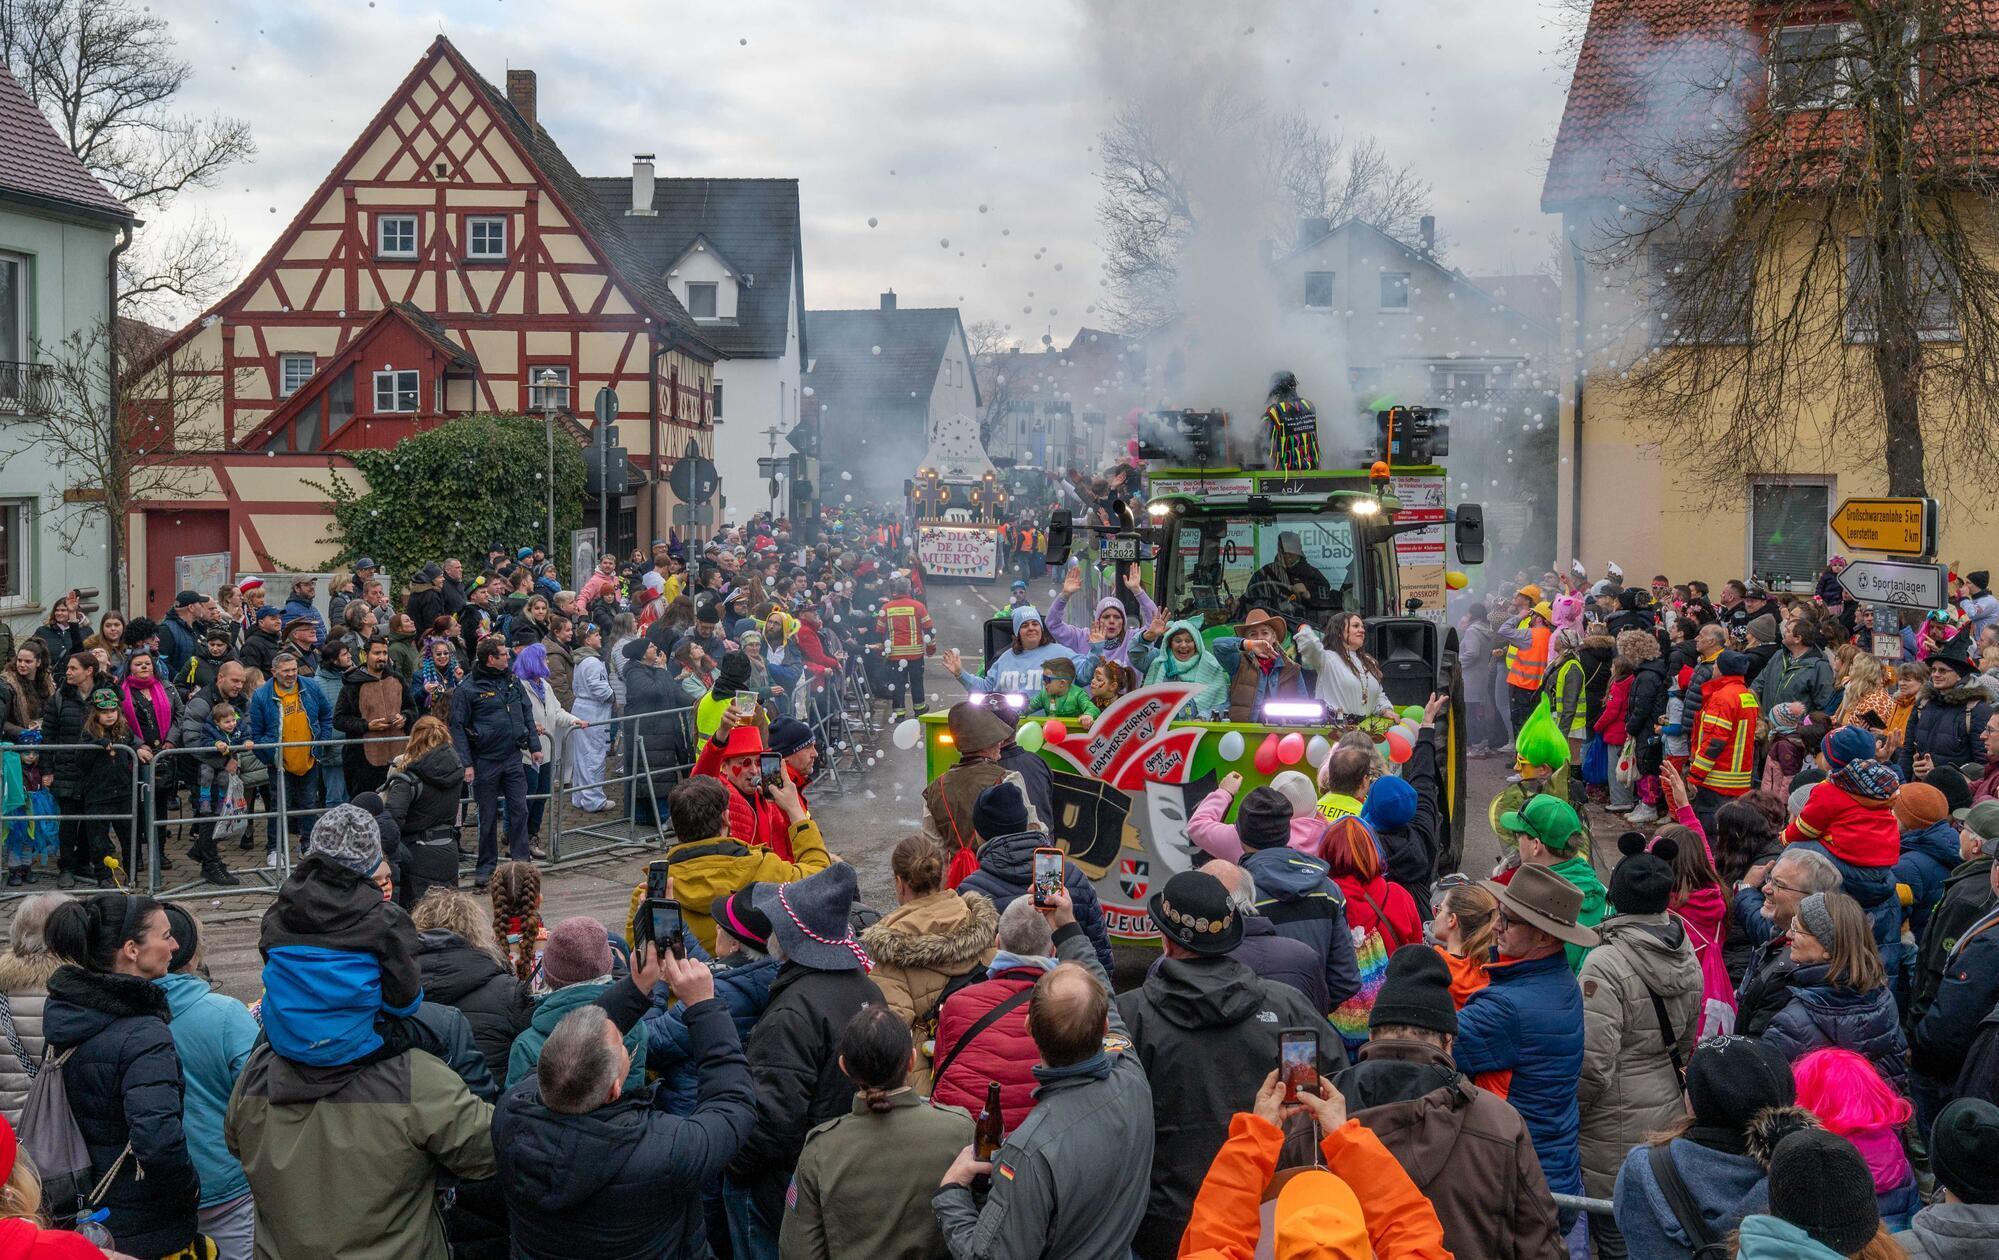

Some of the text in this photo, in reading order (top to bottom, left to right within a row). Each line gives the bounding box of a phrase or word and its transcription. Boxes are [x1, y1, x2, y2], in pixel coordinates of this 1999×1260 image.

[1846, 508, 1920, 523] Großschwarzenlohe 5 km
[947, 531, 968, 542] DIA
[1846, 526, 1919, 543] Leerstetten 2 km
[936, 542, 979, 554] DE LOS
[1108, 541, 1119, 550] RH
[922, 553, 990, 566] MUERTOS
[1114, 549, 1134, 558] 2022
[1872, 576, 1927, 594] Sportanlagen
[1409, 590, 1440, 598] ROSSKOPF
[1090, 700, 1161, 775] HAMMERSTÜRMER
[1088, 737, 1106, 755] DIE
[1159, 752, 1182, 777] 2004
